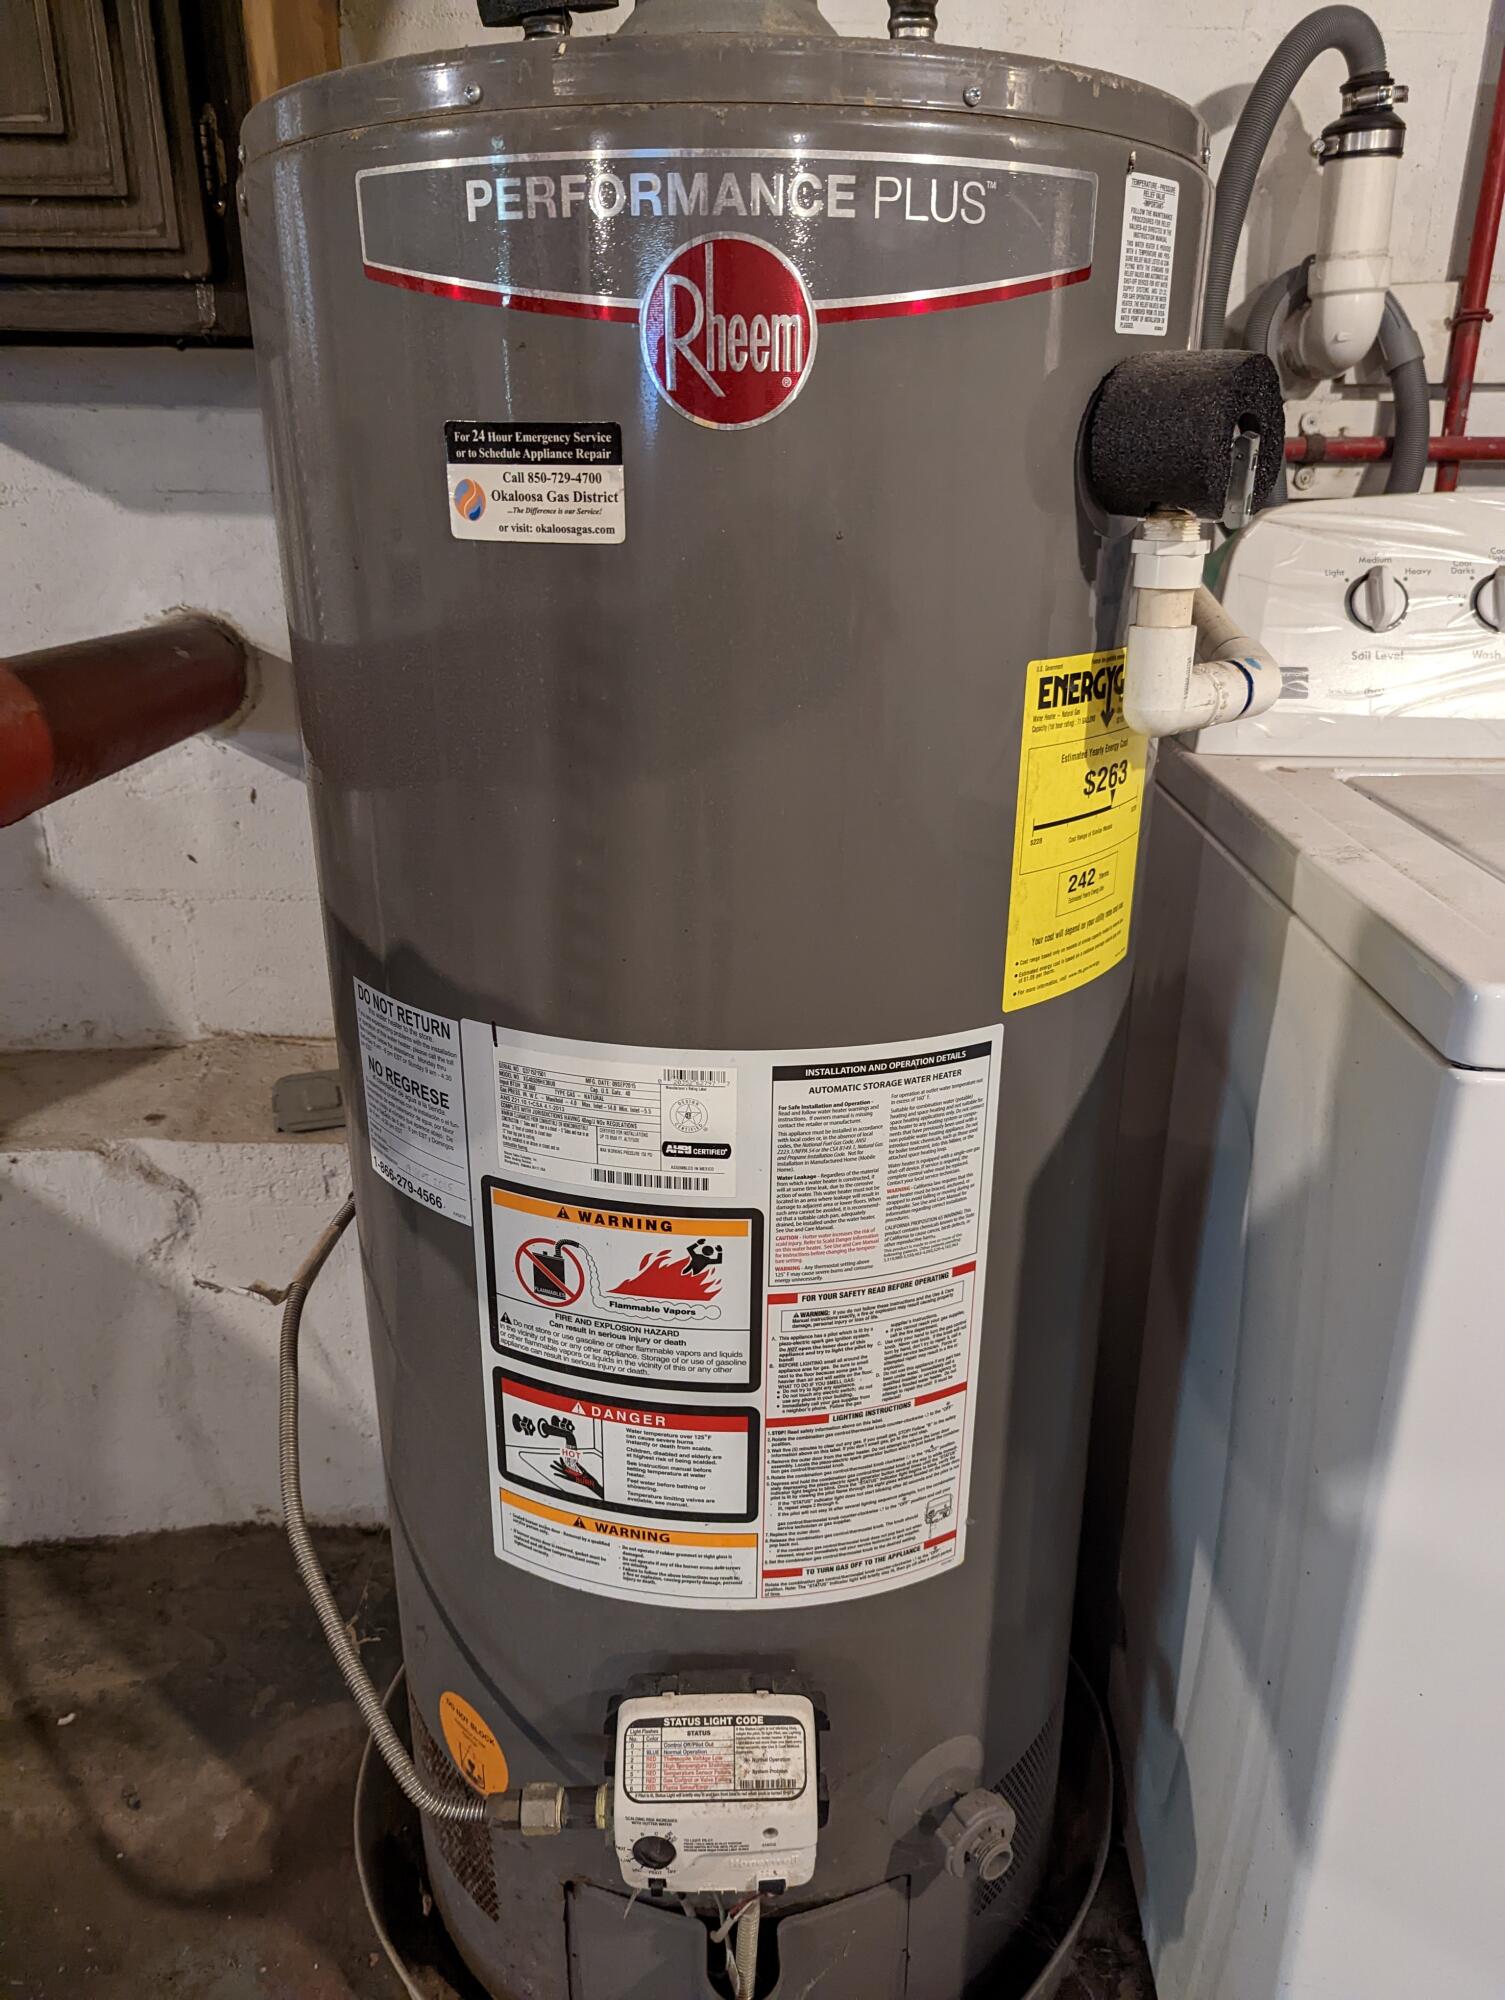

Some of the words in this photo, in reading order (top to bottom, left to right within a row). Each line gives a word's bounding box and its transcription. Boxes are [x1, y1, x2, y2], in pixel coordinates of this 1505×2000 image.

[465, 172, 857, 221] PERFORMANCE
[663, 241, 804, 399] Rheem
[454, 432, 471, 442] For
[472, 430, 485, 442] 24
[487, 432, 513, 442] Hour
[515, 432, 570, 445] Emergency
[573, 432, 613, 443] Service
[456, 451, 466, 459] or
[468, 450, 477, 459] to
[478, 449, 521, 460] Schedule
[523, 449, 573, 462] Appliance
[576, 449, 612, 462] Repair
[503, 471, 525, 483] Call
[528, 472, 603, 484] 850-729-4700
[491, 489, 544, 503] Okaloosa
[546, 490, 571, 504] Gas
[573, 490, 619, 504] District
[526, 507, 557, 517] Difference
[558, 508, 564, 516] is
[577, 507, 603, 516] Service!
[498, 525, 509, 534] or
[511, 523, 534, 533] visit:
[535, 523, 616, 537] okaloosagas.com
[1358, 554, 1393, 563] Medium
[1324, 568, 1345, 578] Light
[1404, 567, 1432, 577] Heavy
[1350, 650, 1373, 661] Soil
[1038, 664, 1125, 719] ENERGYG
[1060, 751, 1088, 764] Estimated
[1089, 747, 1104, 757] Yearly
[1105, 743, 1119, 754] Energy
[1083, 759, 1128, 799] $263
[1067, 867, 1096, 894] 242
[1031, 936, 1043, 947] Your
[357, 984, 371, 1005] DO
[372, 993, 393, 1018] NOT
[396, 1005, 451, 1041] RETURN
[805, 1063, 867, 1077] INSTALLATION
[869, 1060, 888, 1073] AND
[889, 1055, 936, 1071] OPERATION
[937, 1050, 968, 1066] DETAILS
[368, 1055, 383, 1078] NO
[385, 1065, 450, 1110] REGRESE
[809, 1082, 862, 1096] AUTOMATIC
[863, 1078, 903, 1092] STORAGE
[904, 1074, 933, 1088] WATER
[933, 1068, 963, 1084] HEATER
[778, 1104, 787, 1112] For
[788, 1103, 801, 1111] Safe
[802, 1101, 833, 1110] Installation
[834, 1100, 844, 1108] and
[845, 1099, 871, 1108] Operation
[693, 1148, 727, 1156] CERTIFIED
[373, 1155, 443, 1210] 1-866-279-4566
[578, 1211, 673, 1232] WARNING
[801, 1294, 817, 1303] FOR
[818, 1292, 838, 1301] YOUR
[839, 1288, 866, 1299] SAFETY
[867, 1285, 886, 1296] READ
[887, 1281, 914, 1293] BEFORE
[914, 1271, 950, 1288] OPERATING
[609, 1301, 660, 1314] Flammable
[663, 1307, 696, 1316] Vapors
[549, 1320, 564, 1329] Can
[565, 1324, 587, 1334] result
[597, 1330, 627, 1341] serious
[628, 1335, 651, 1346] injury
[664, 1339, 687, 1347] death
[555, 1313, 573, 1323] FIRE
[574, 1316, 592, 1326] AND
[594, 1319, 642, 1334] EXPLOSION
[643, 1327, 680, 1338] HAZARD
[513, 1319, 523, 1328] Do
[524, 1323, 534, 1331] not
[535, 1326, 551, 1336] store
[562, 1333, 574, 1341] use
[576, 1336, 605, 1348] gasoline
[616, 1342, 634, 1351] other
[636, 1344, 674, 1356] flammable
[675, 1349, 701, 1358] vapors
[703, 1350, 717, 1358] and
[719, 1351, 743, 1359] liquids
[641, 1353, 670, 1364] Storage
[671, 1355, 679, 1363] of
[706, 1358, 714, 1366] of
[715, 1358, 747, 1367] gasoline
[591, 1405, 667, 1427] DANGER
[833, 1410, 864, 1422] LIGHTING
[865, 1401, 912, 1417] INSTRUCTIONS
[562, 1448, 581, 1459] HOT
[595, 1521, 672, 1544] WARNING
[806, 1567, 815, 1576] TO
[817, 1565, 835, 1575] TURN
[836, 1564, 849, 1572] GAS
[850, 1561, 863, 1570] OFF
[875, 1555, 887, 1564] THE
[887, 1545, 921, 1561] APPLIANCE
[663, 1717, 702, 1727] STATUS
[703, 1716, 733, 1726] LIGHT
[736, 1715, 764, 1726] CODE
